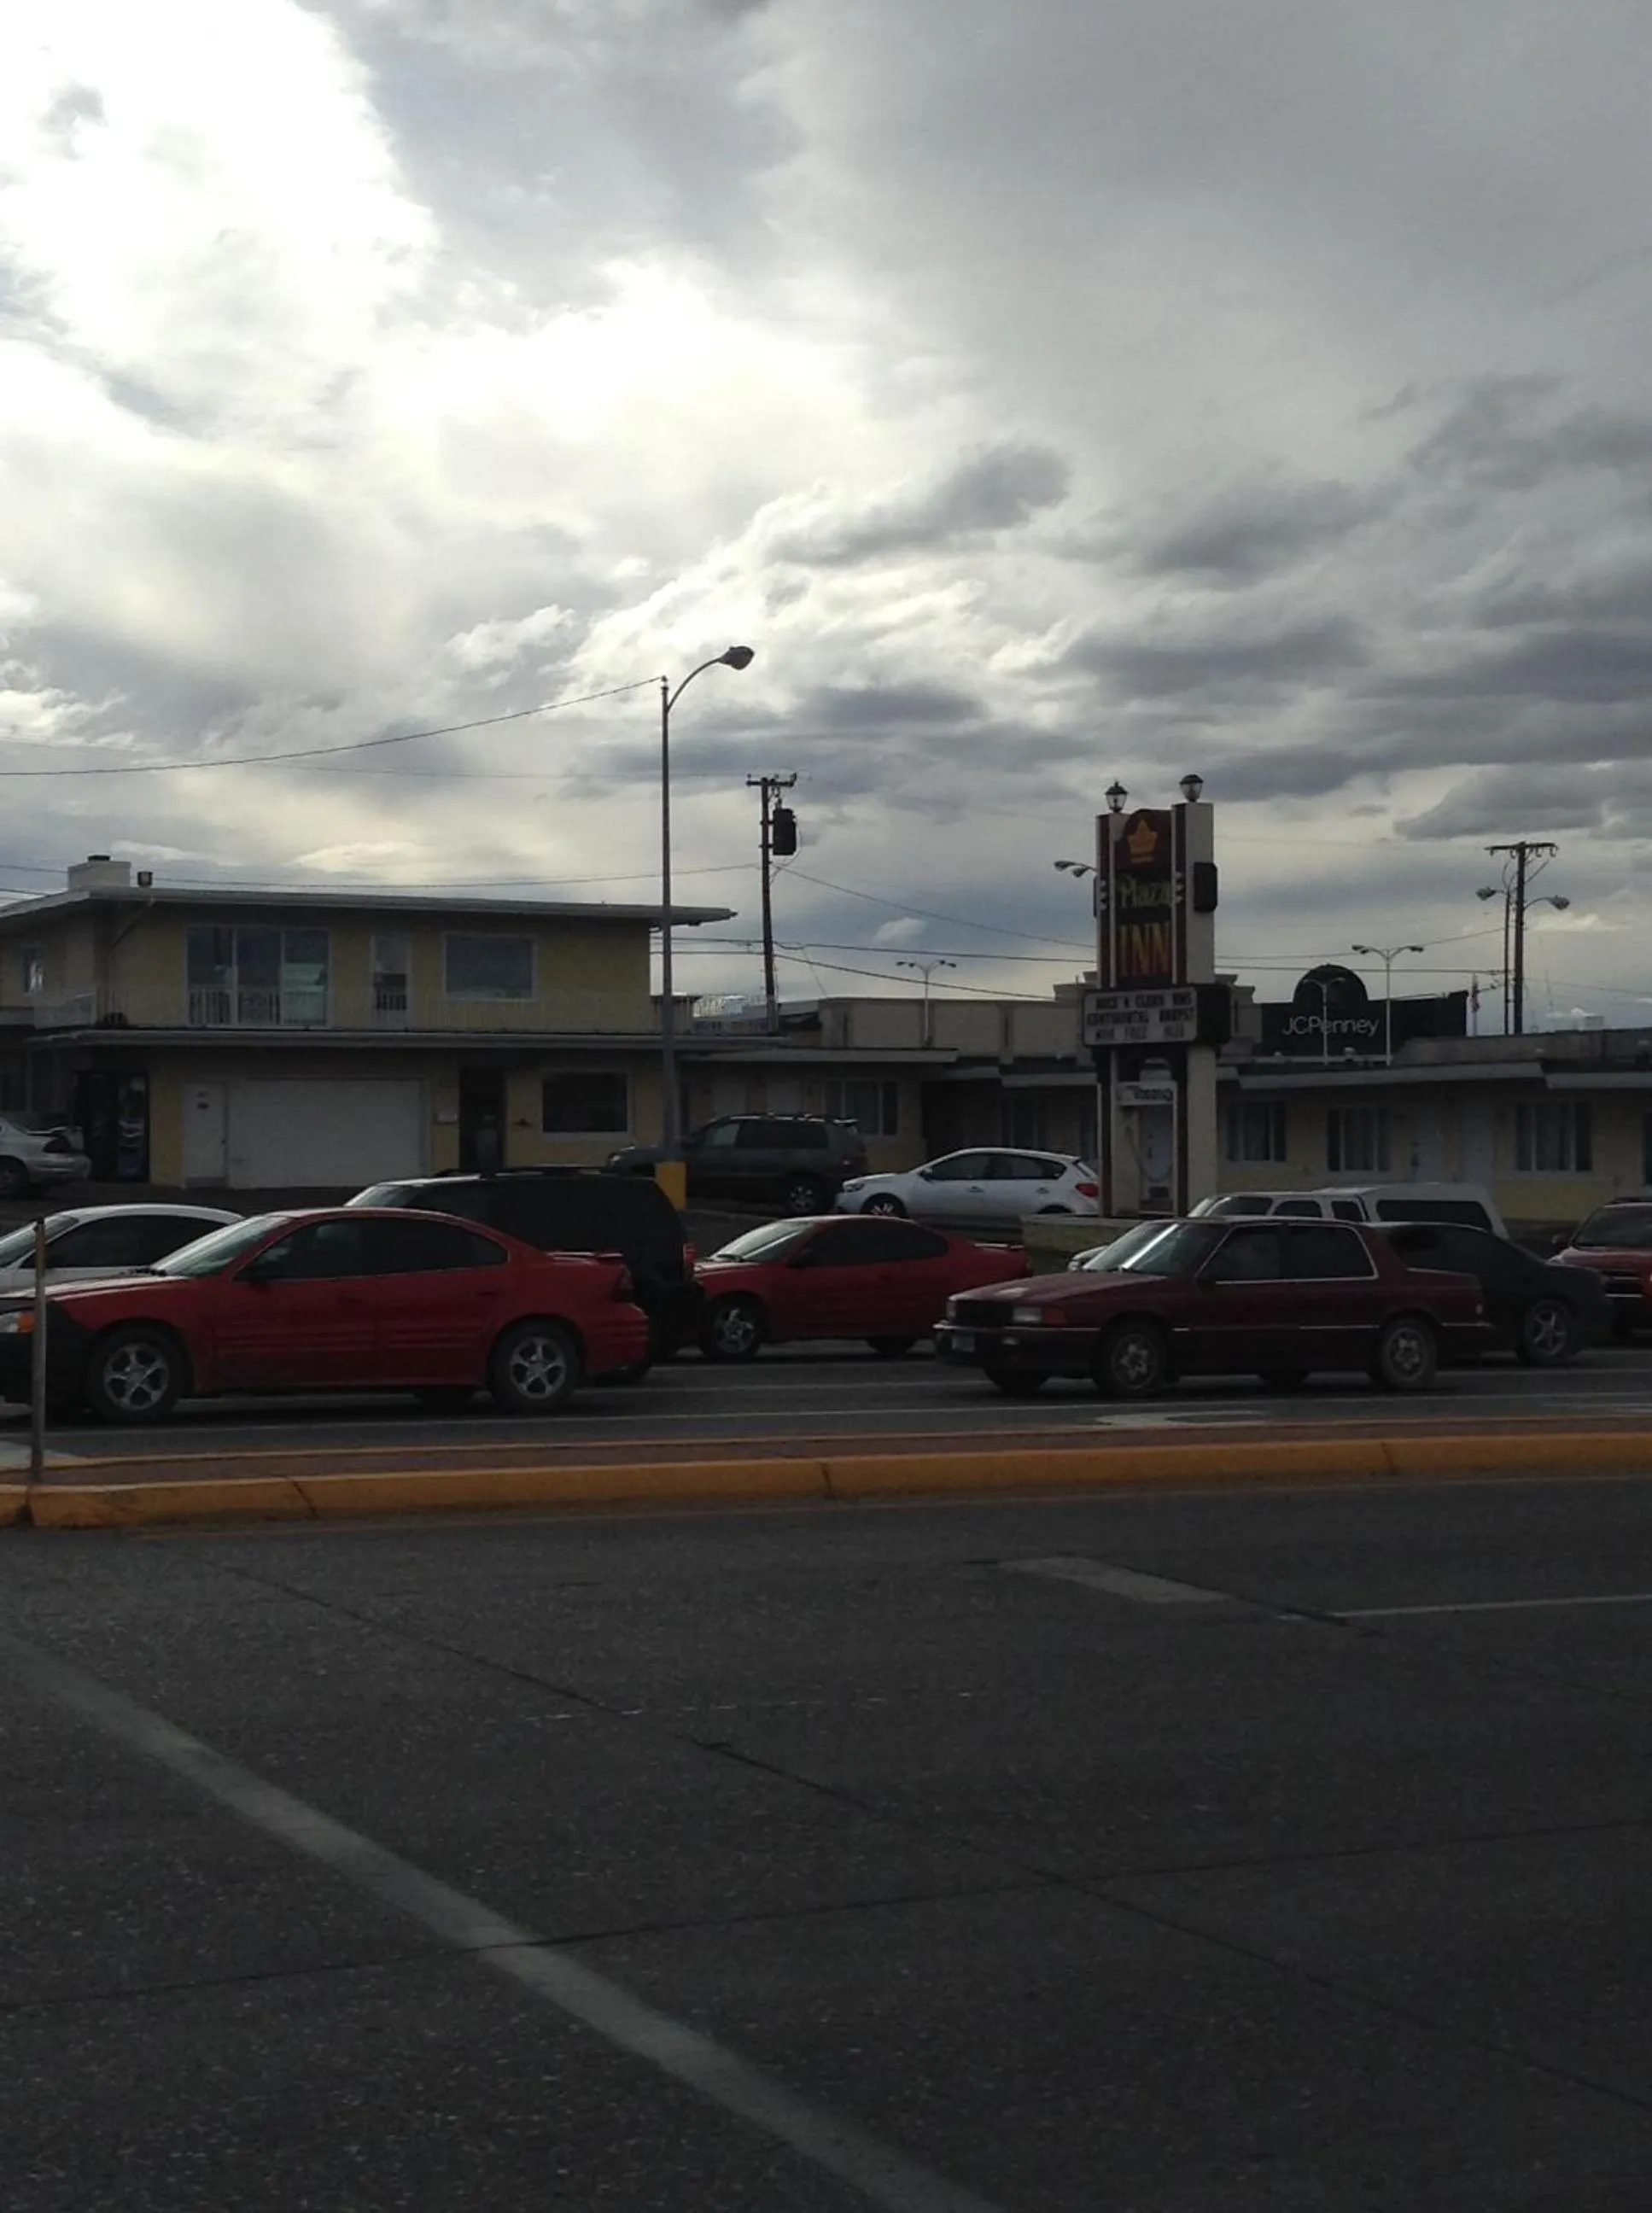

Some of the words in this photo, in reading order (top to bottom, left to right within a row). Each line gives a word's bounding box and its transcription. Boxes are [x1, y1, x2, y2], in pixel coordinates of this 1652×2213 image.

[1117, 873, 1170, 908] Plaza
[1119, 919, 1170, 976] INN
[1281, 1014, 1381, 1037] JCPenney
